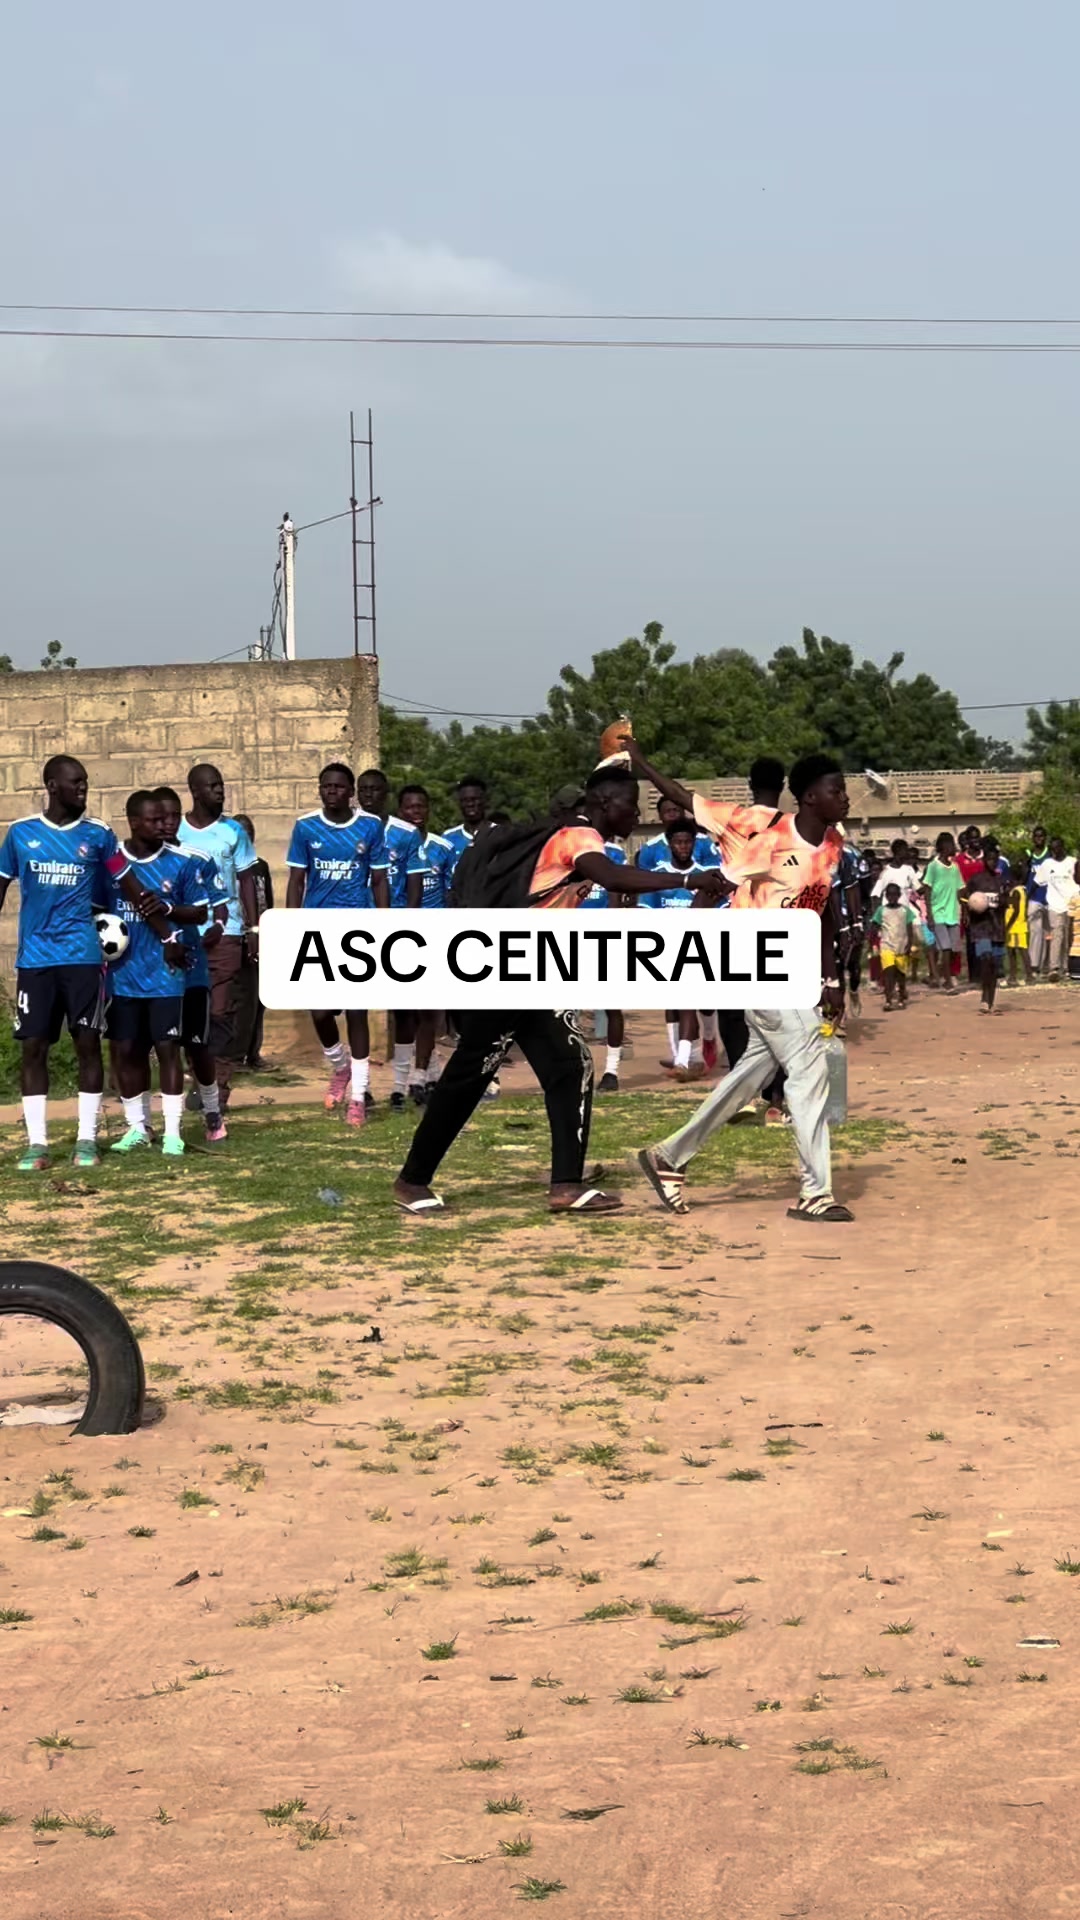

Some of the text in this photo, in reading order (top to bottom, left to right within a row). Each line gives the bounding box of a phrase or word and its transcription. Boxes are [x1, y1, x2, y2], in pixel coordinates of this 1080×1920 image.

[29, 859, 86, 874] Emirates
[799, 882, 827, 898] ASC
[18, 989, 30, 1014] 4
